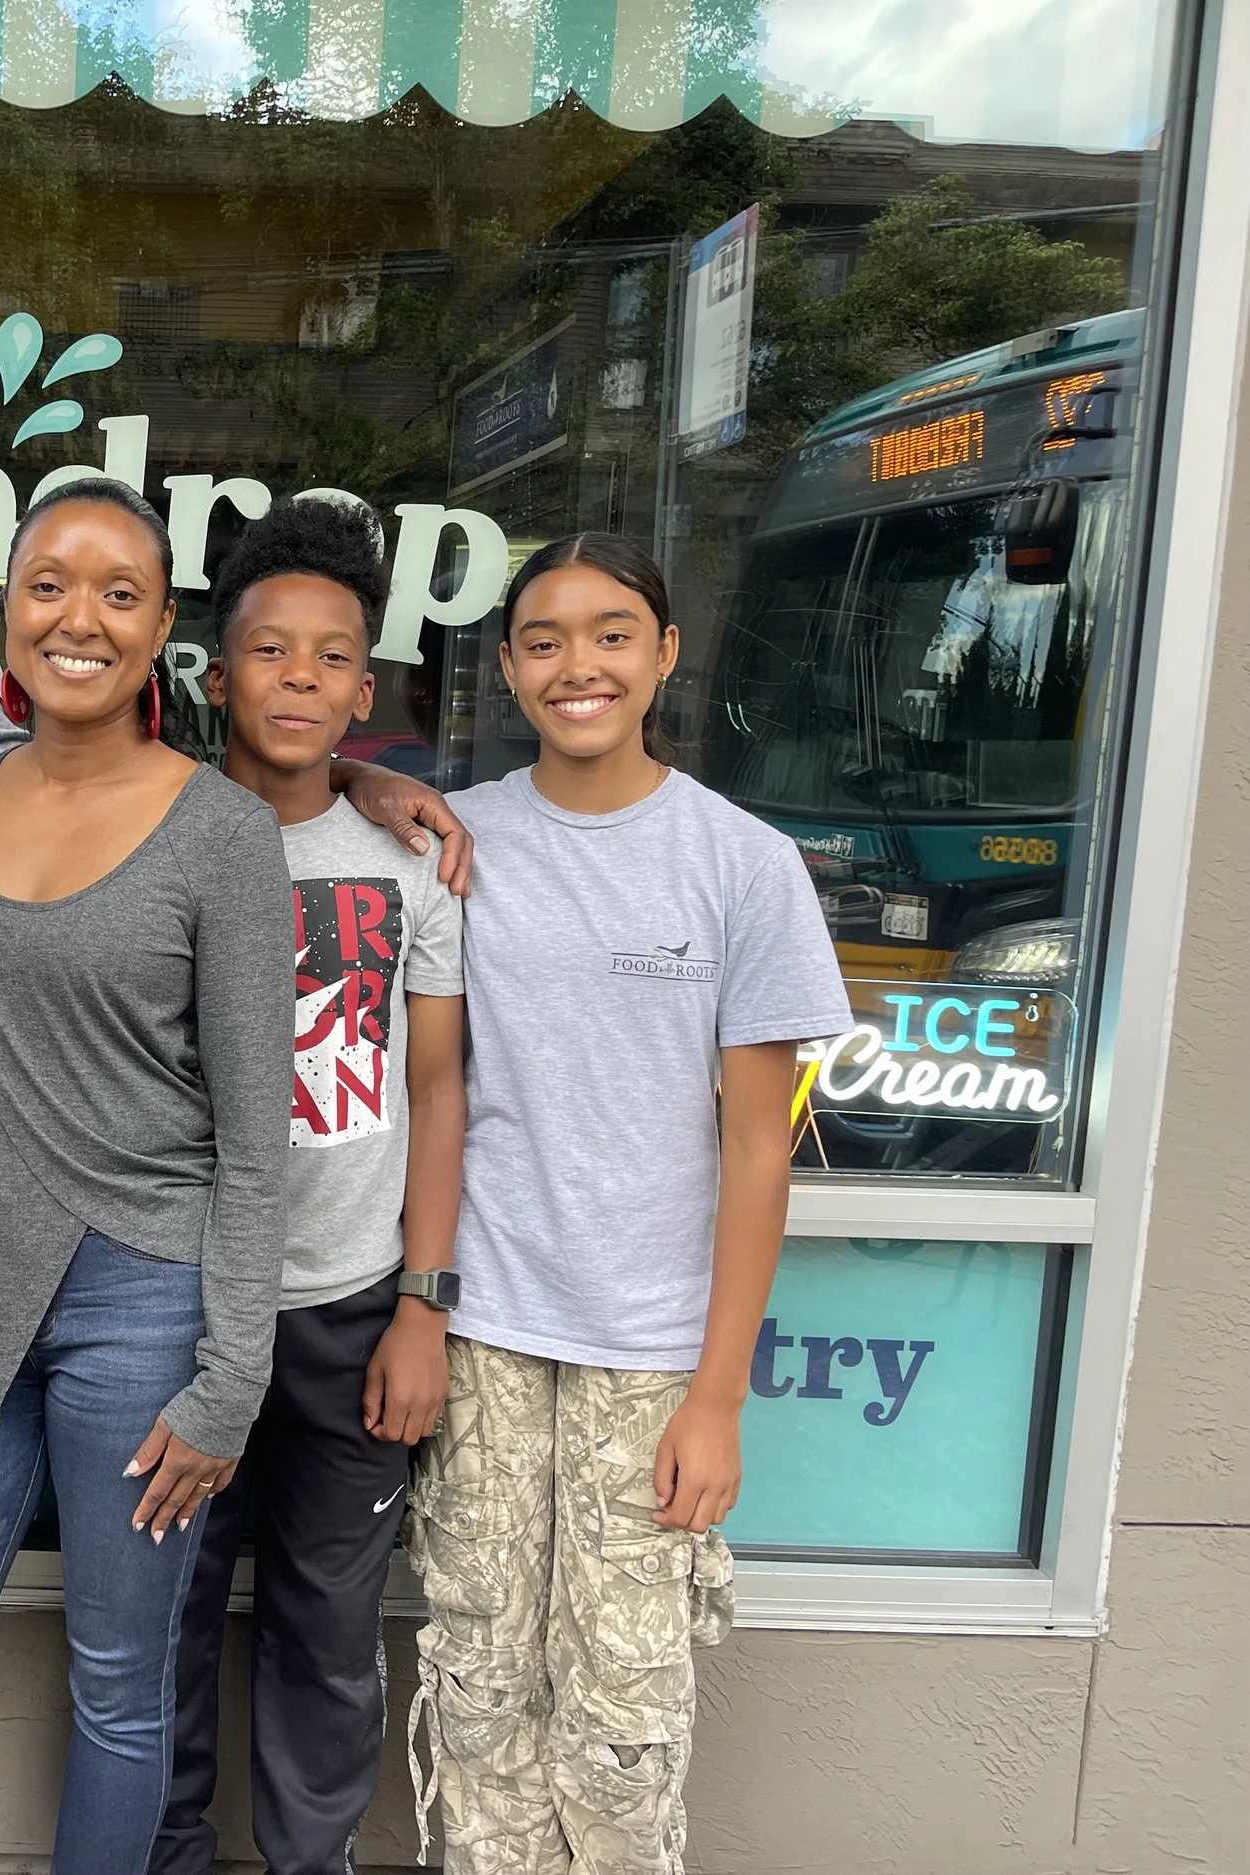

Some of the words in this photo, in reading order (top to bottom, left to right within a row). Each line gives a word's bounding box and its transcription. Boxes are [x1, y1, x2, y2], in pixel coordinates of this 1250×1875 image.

[612, 957, 659, 974] FOOD
[295, 970, 385, 1052] OR
[882, 995, 1019, 1057] ICE
[290, 1047, 383, 1135] AN
[802, 1024, 1059, 1112] Cream
[750, 1317, 935, 1427] try
